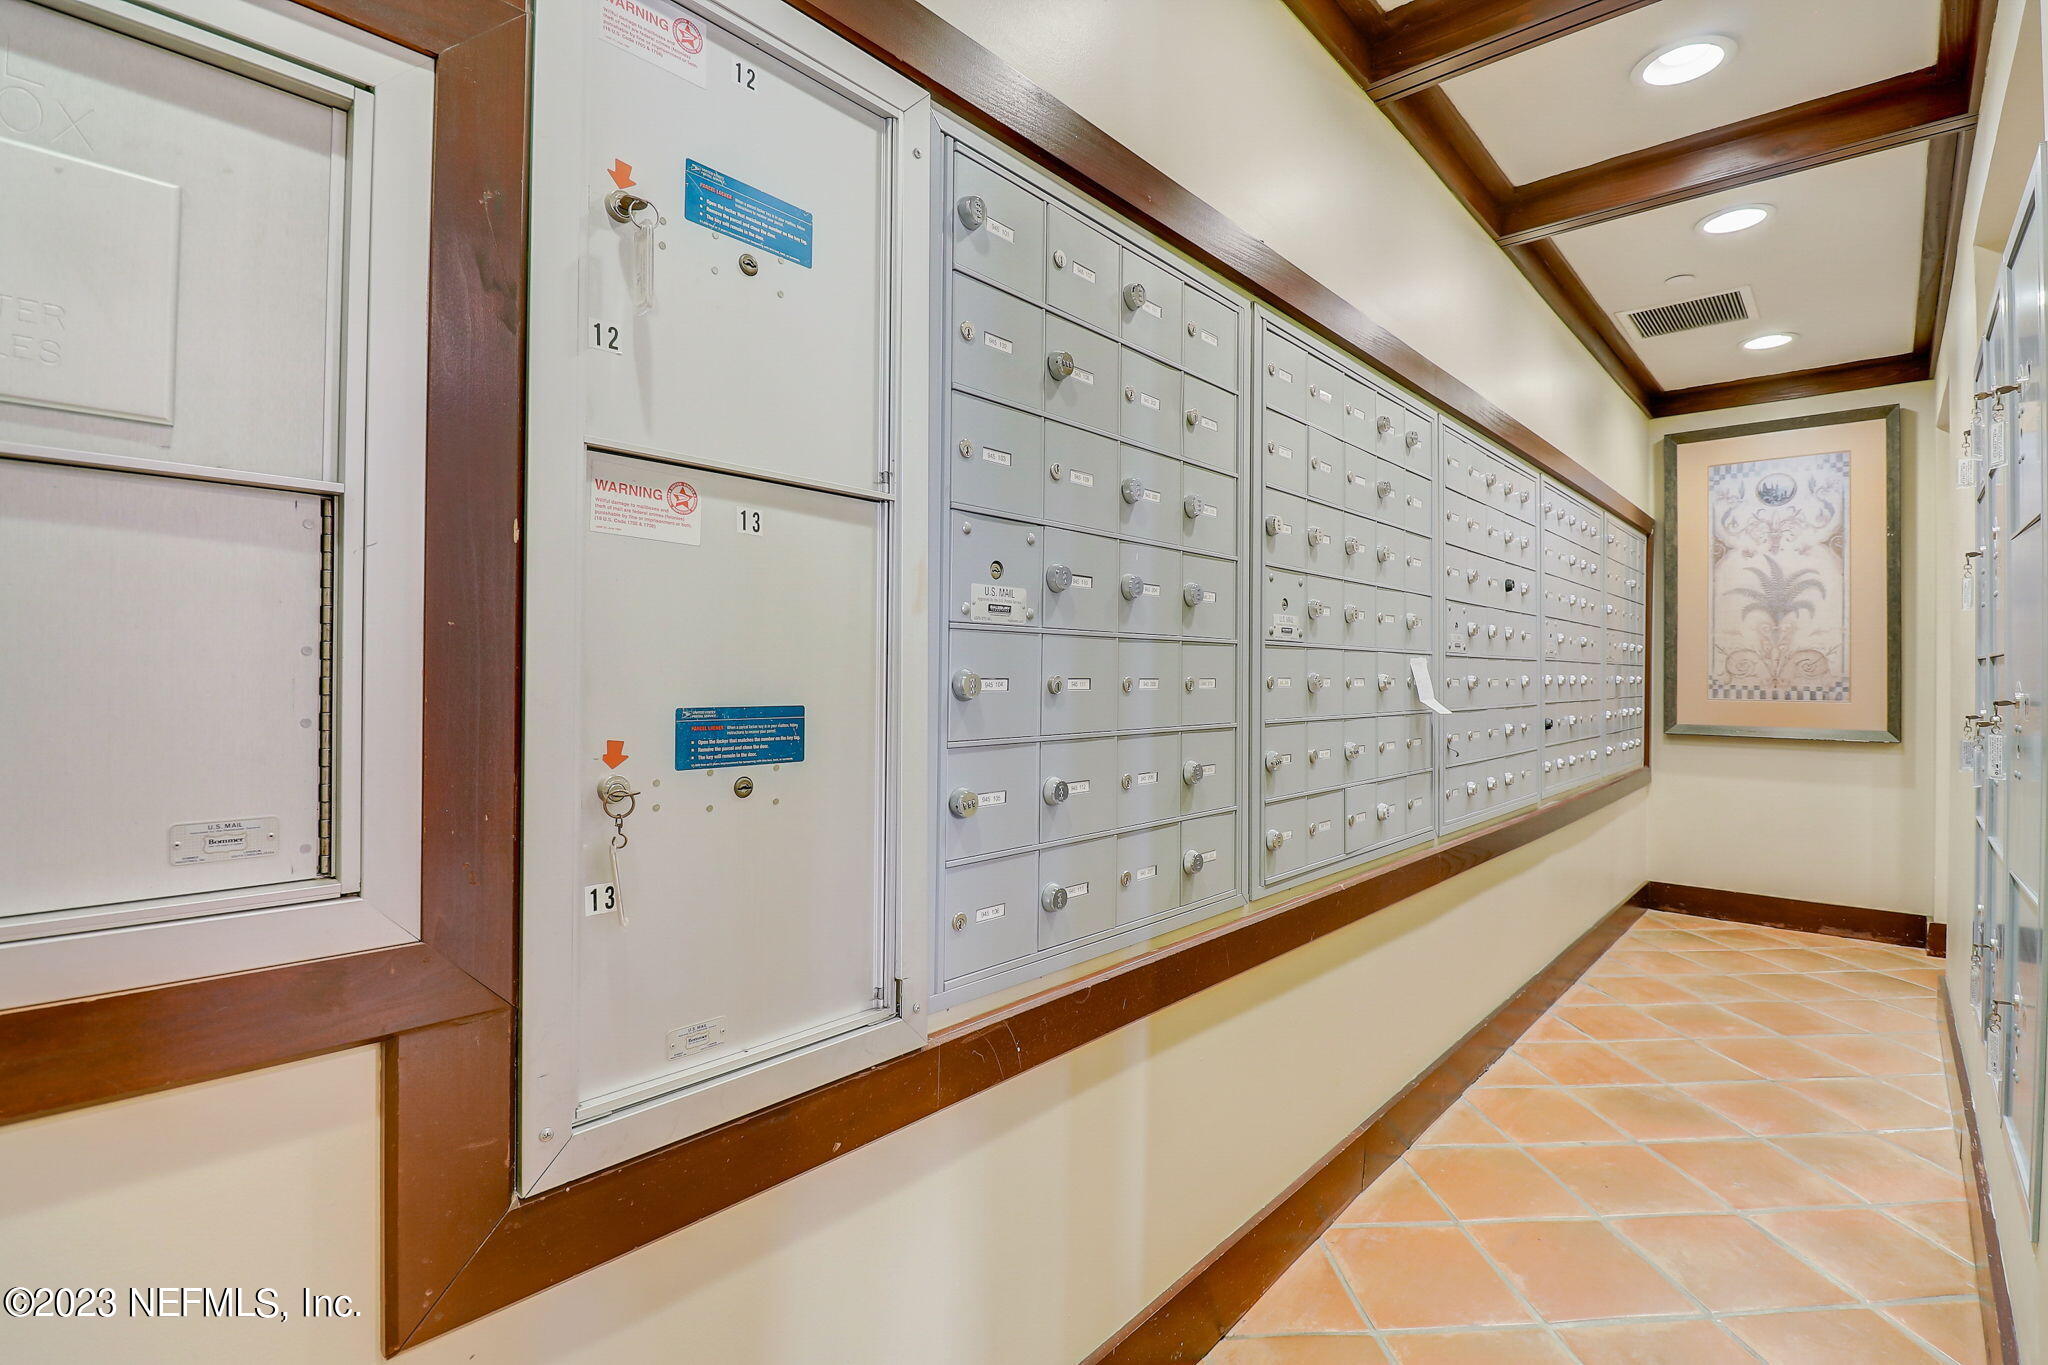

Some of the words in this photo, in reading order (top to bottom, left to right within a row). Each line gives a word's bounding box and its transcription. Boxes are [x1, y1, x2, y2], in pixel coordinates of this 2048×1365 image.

[736, 62, 756, 90] 12
[594, 322, 619, 350] 12
[594, 479, 663, 500] WARNING
[740, 510, 760, 533] 13
[590, 886, 615, 911] 13
